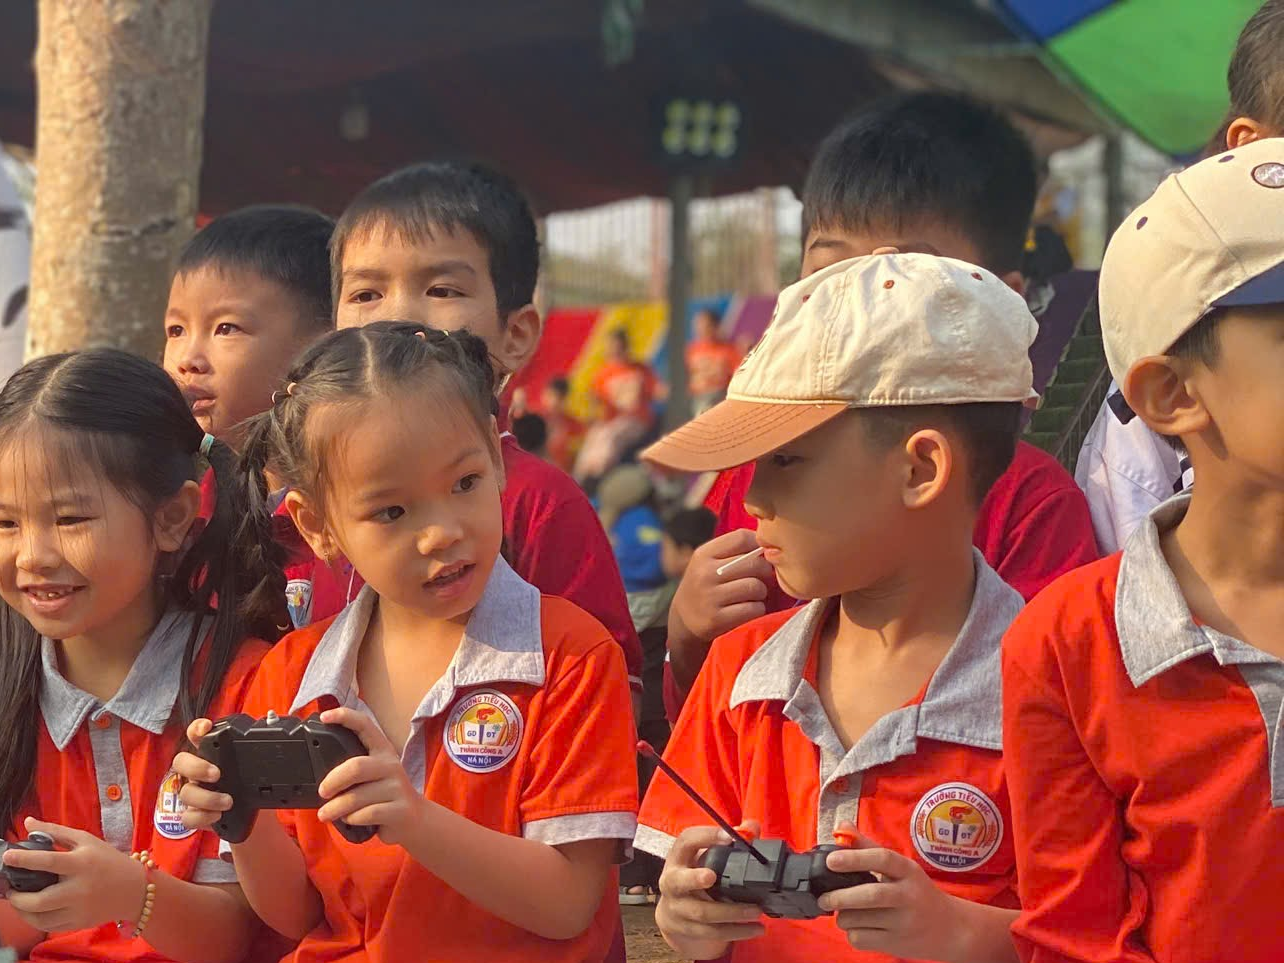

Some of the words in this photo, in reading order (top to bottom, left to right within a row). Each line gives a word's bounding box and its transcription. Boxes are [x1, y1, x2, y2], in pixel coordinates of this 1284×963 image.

[499, 702, 512, 715] HỌC
[926, 791, 956, 808] TRƯỜNG
[958, 791, 977, 804] TIỂU
[976, 801, 991, 816] HỌC
[938, 828, 949, 836] GD
[953, 847, 972, 856] CÔNG
